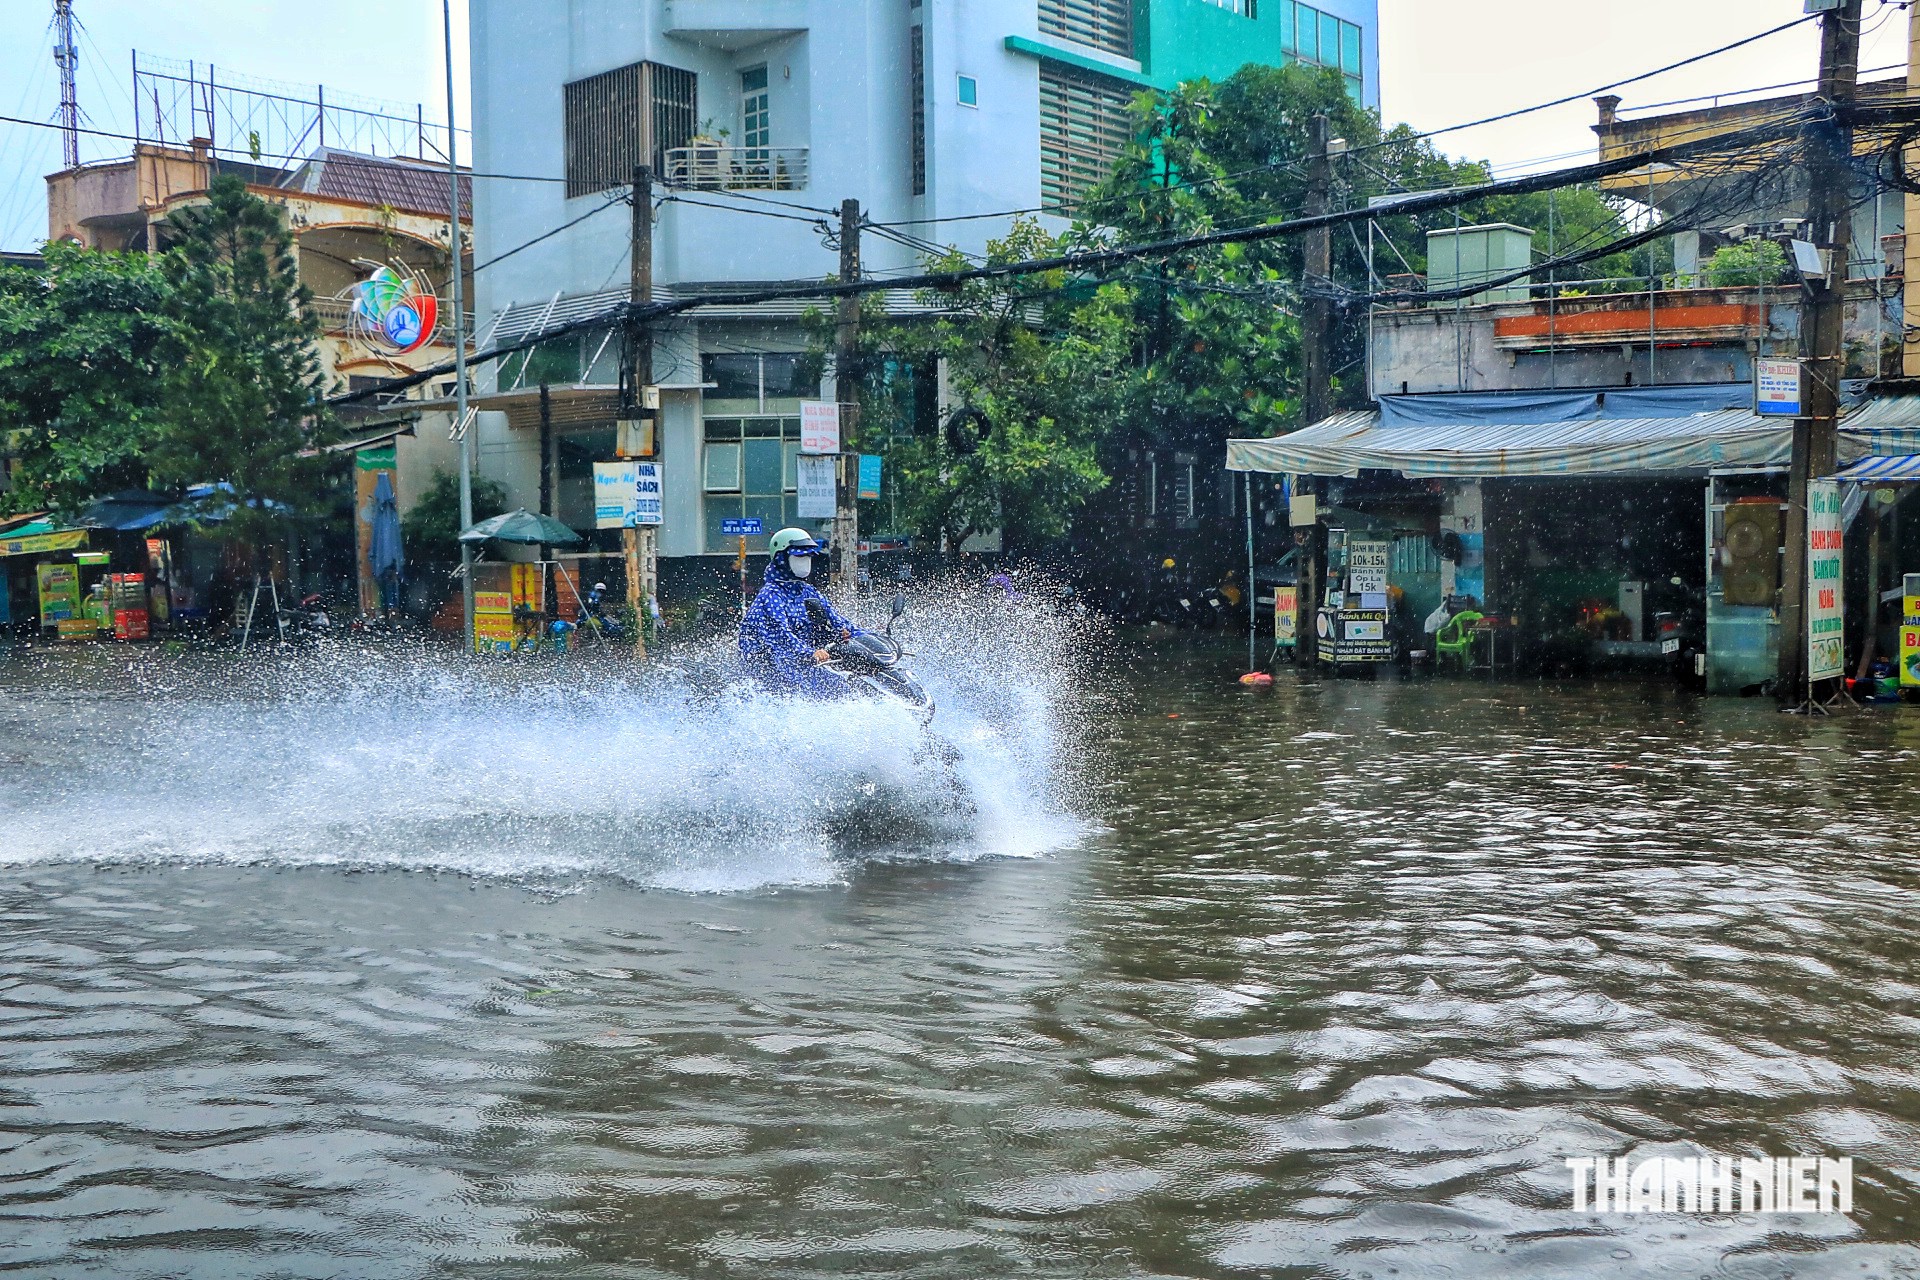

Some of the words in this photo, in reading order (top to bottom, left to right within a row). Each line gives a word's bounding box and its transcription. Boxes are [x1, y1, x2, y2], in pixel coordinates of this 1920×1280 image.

[636, 478, 659, 493] SÁCH
[1352, 542, 1367, 553] BÁNH
[1352, 554, 1385, 566] 10k-15k
[1359, 583, 1377, 592] 15k
[1337, 610, 1359, 620] Bánh
